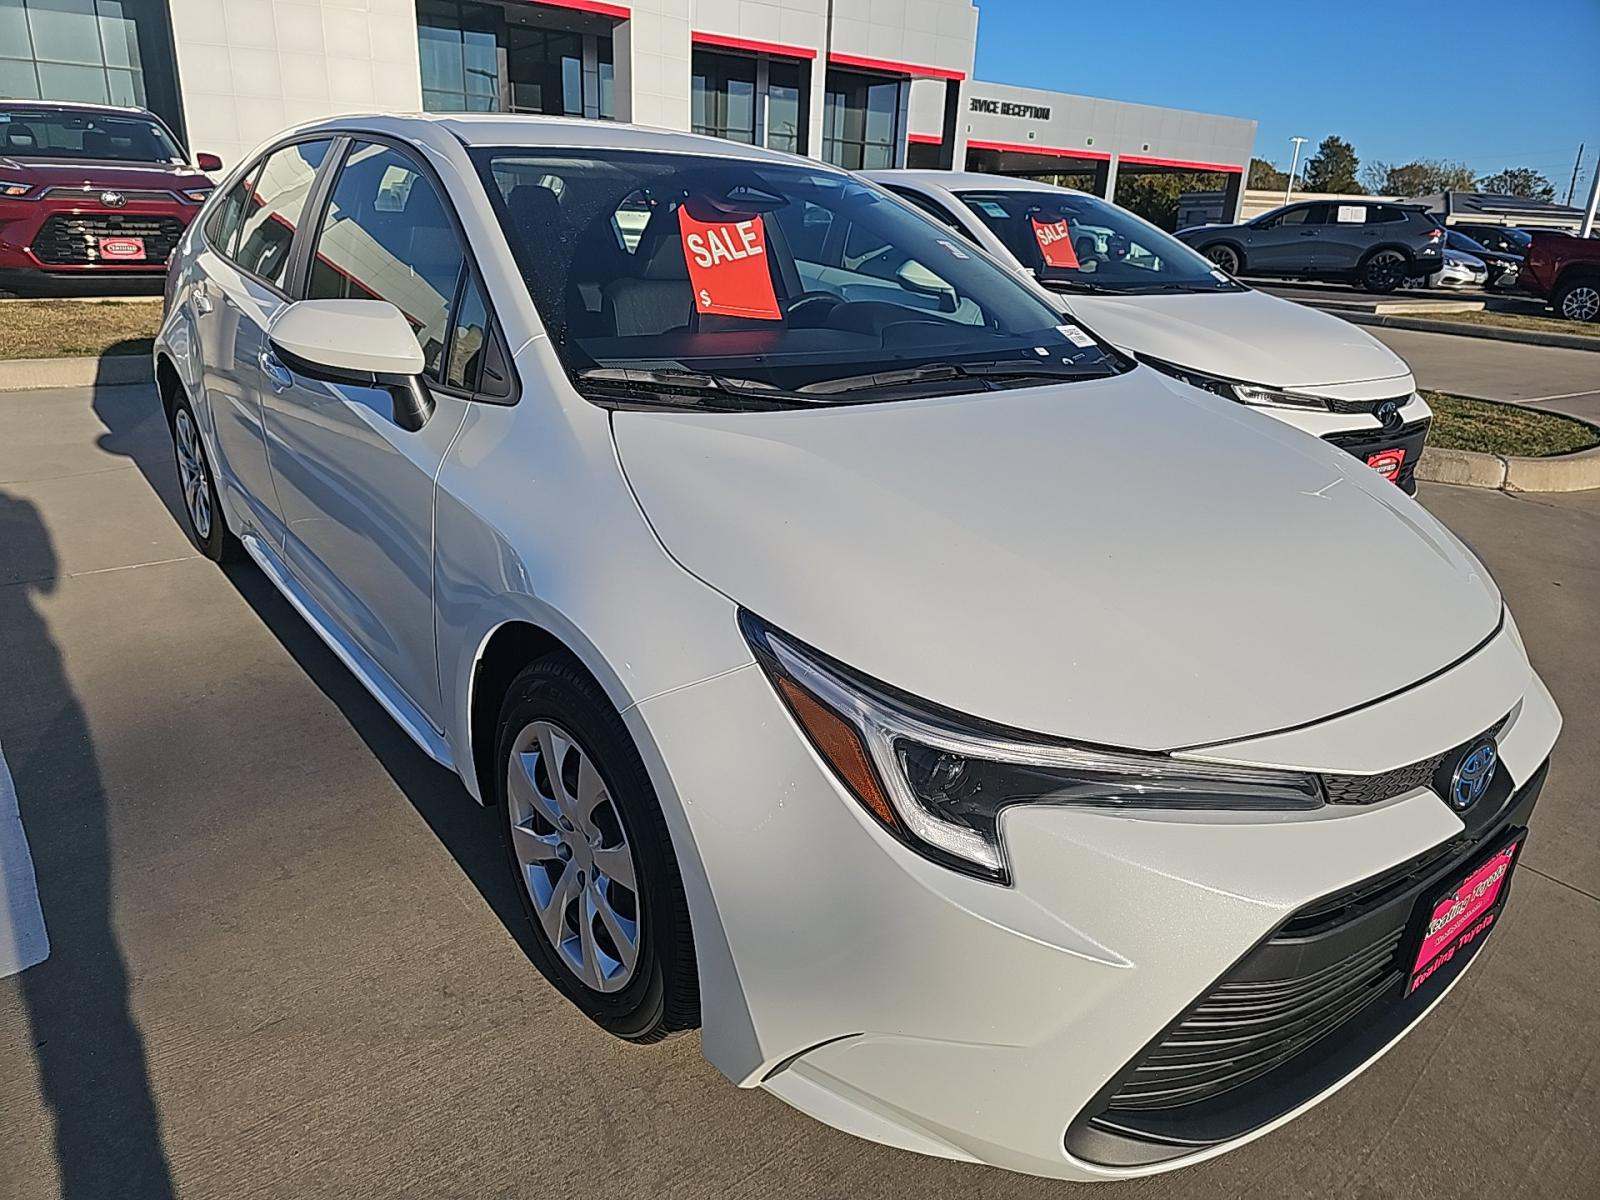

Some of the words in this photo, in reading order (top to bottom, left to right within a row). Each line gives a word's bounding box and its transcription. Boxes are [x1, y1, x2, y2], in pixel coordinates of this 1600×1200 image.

[1001, 102, 1051, 121] RECEPTION
[687, 221, 763, 268] SALE
[1036, 223, 1068, 246] SALE
[699, 289, 712, 307] $
[1471, 864, 1507, 902] Toyota
[1459, 914, 1494, 949] Toyota
